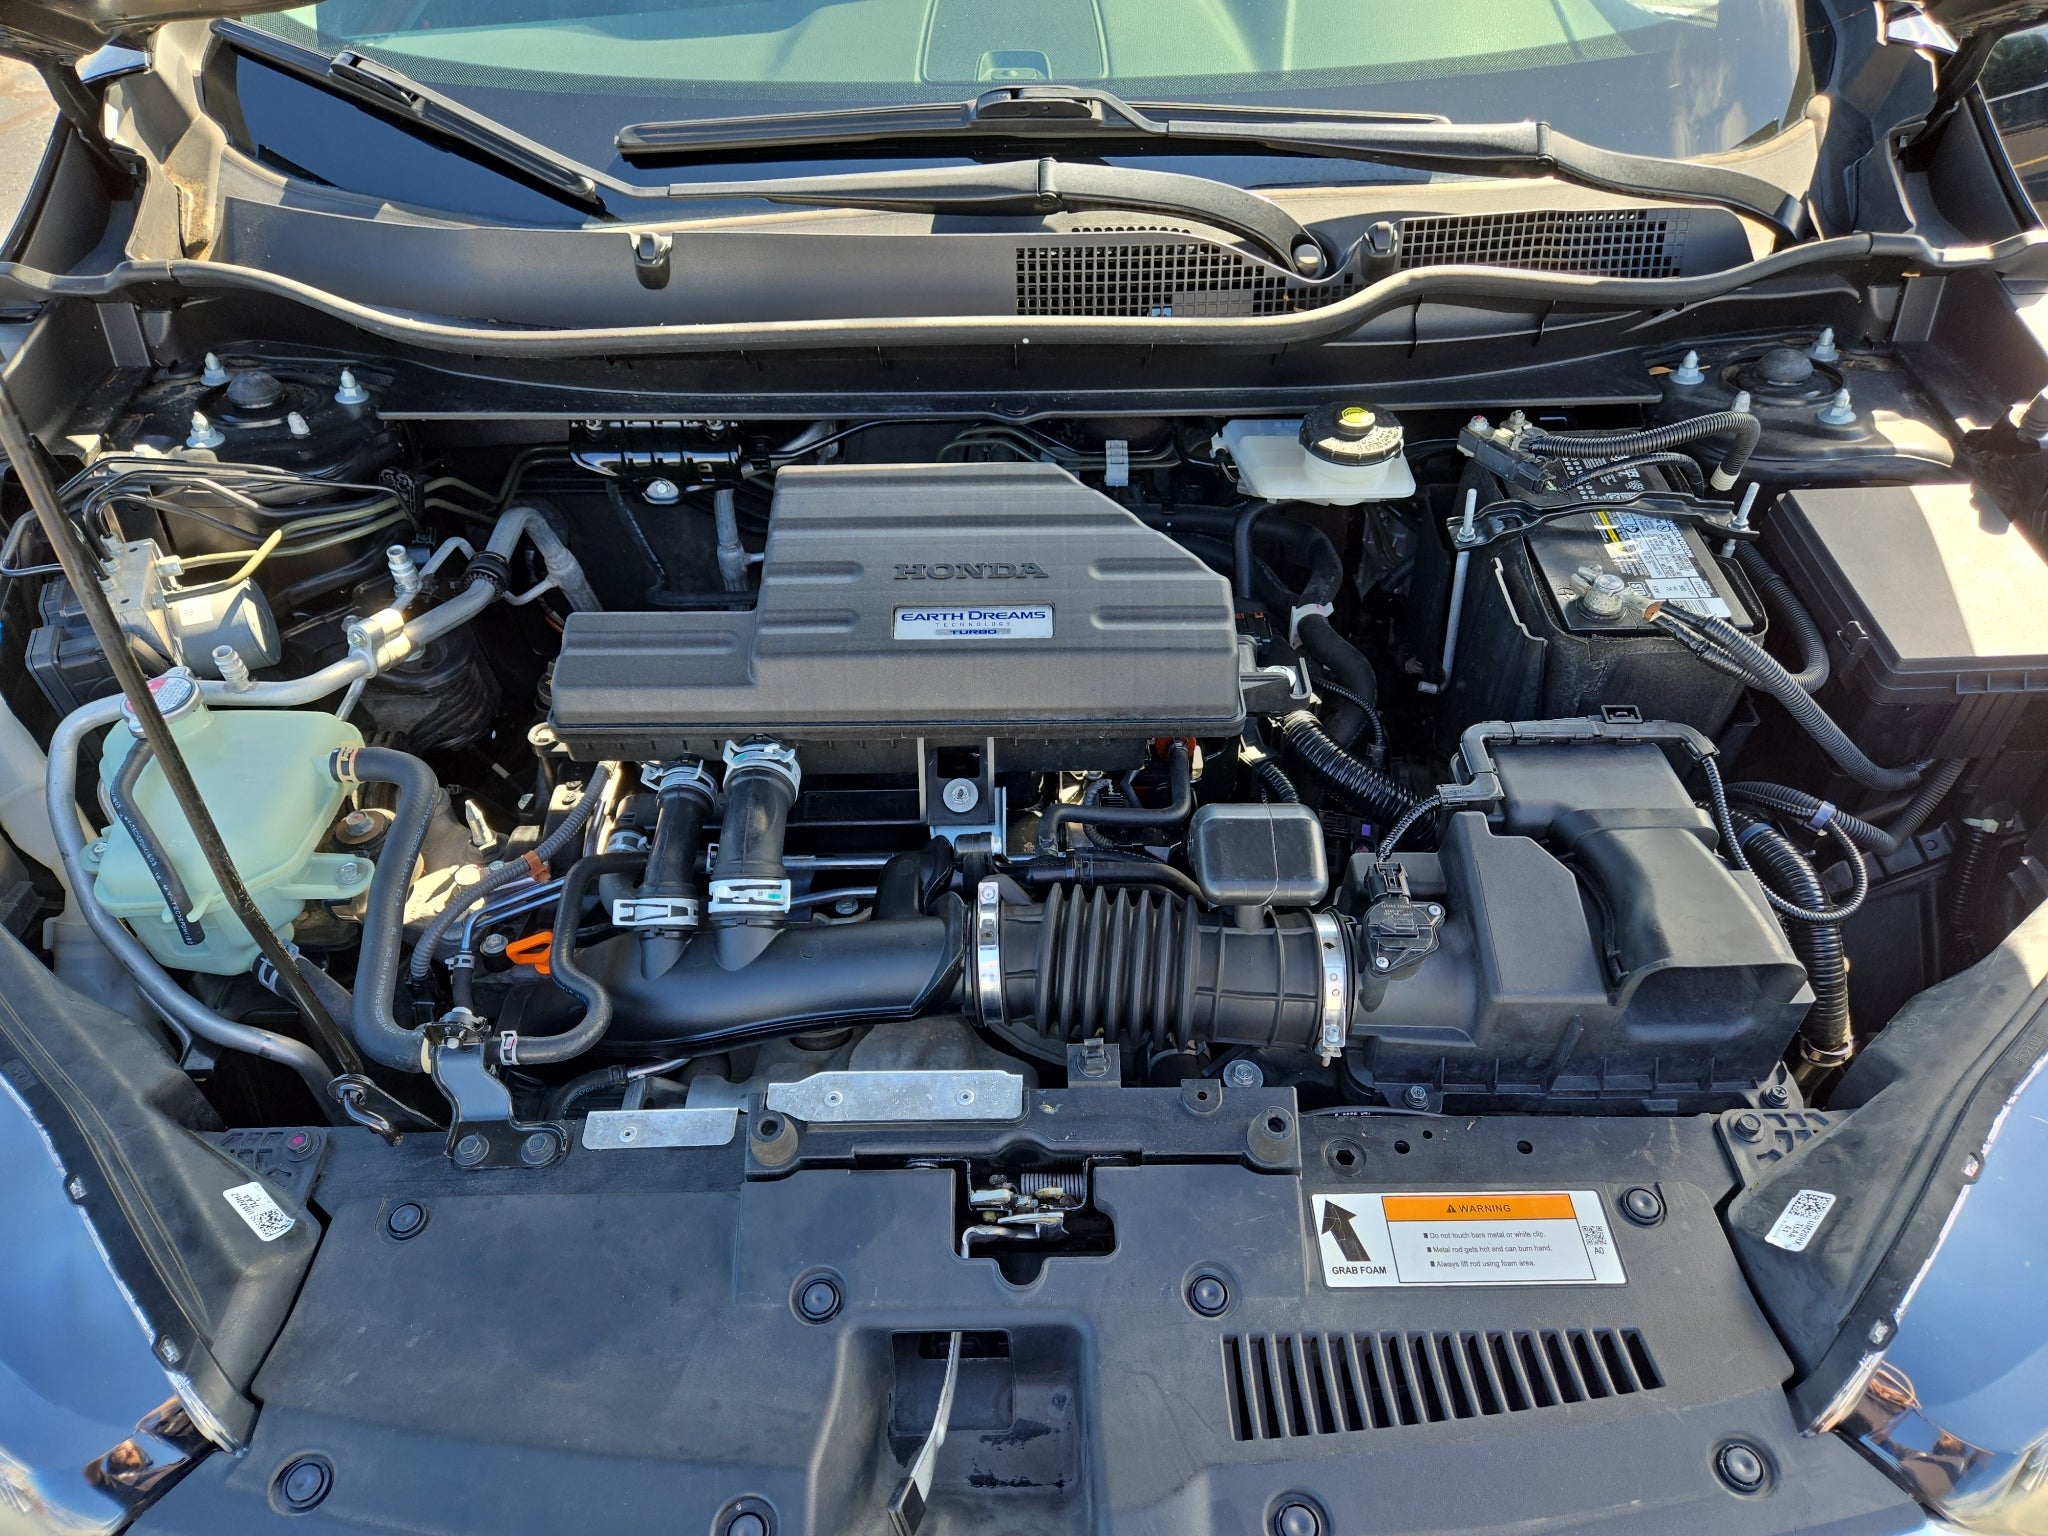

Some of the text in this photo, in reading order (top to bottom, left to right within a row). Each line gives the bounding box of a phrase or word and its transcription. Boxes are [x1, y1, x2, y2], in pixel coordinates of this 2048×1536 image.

[1679, 536, 1695, 558] POISON
[894, 562, 1050, 580] HONDA
[901, 612, 964, 622] EARTH
[1459, 1204, 1512, 1213] WARNING
[1532, 1231, 1547, 1239] clip.
[1464, 1246, 1479, 1254] gets
[1436, 1260, 1460, 1269] Always
[1460, 1260, 1469, 1268] lift
[1482, 1260, 1500, 1269] using
[1501, 1259, 1518, 1267] foam
[1332, 1266, 1387, 1275] GRAB FOAM
